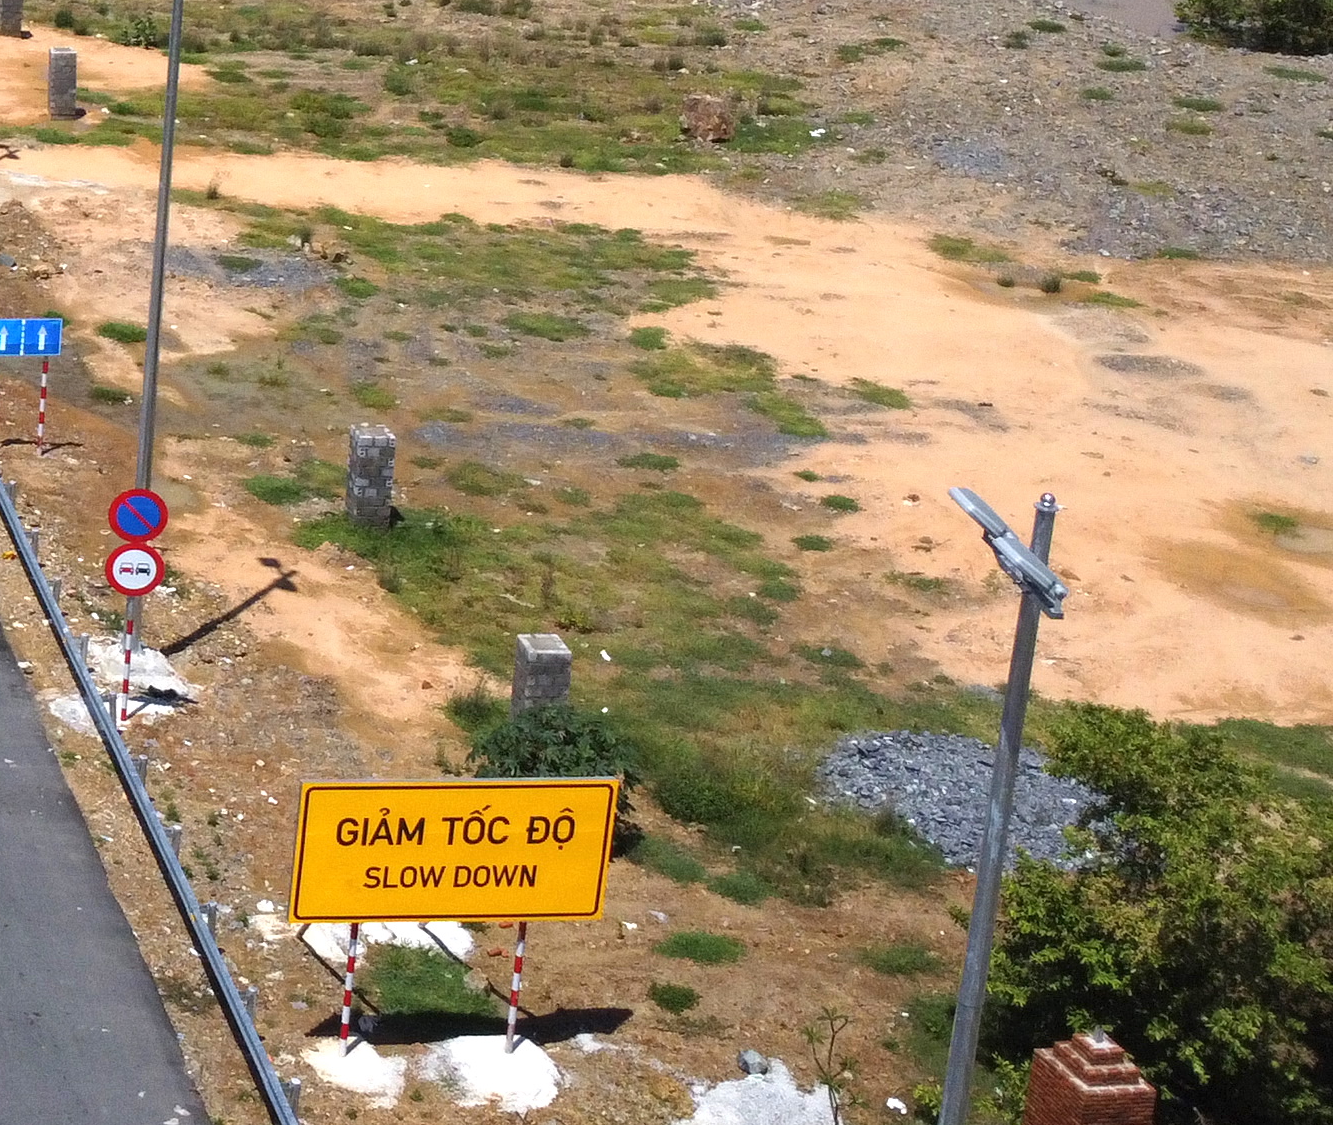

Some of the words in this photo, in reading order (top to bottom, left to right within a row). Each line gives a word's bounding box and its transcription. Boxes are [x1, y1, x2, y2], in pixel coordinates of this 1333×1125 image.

[336, 808, 426, 846] GIẢM
[442, 805, 510, 845] TỐC
[526, 808, 576, 850] ĐỘ
[363, 866, 446, 888] SLOW
[453, 865, 537, 887] DOWN
